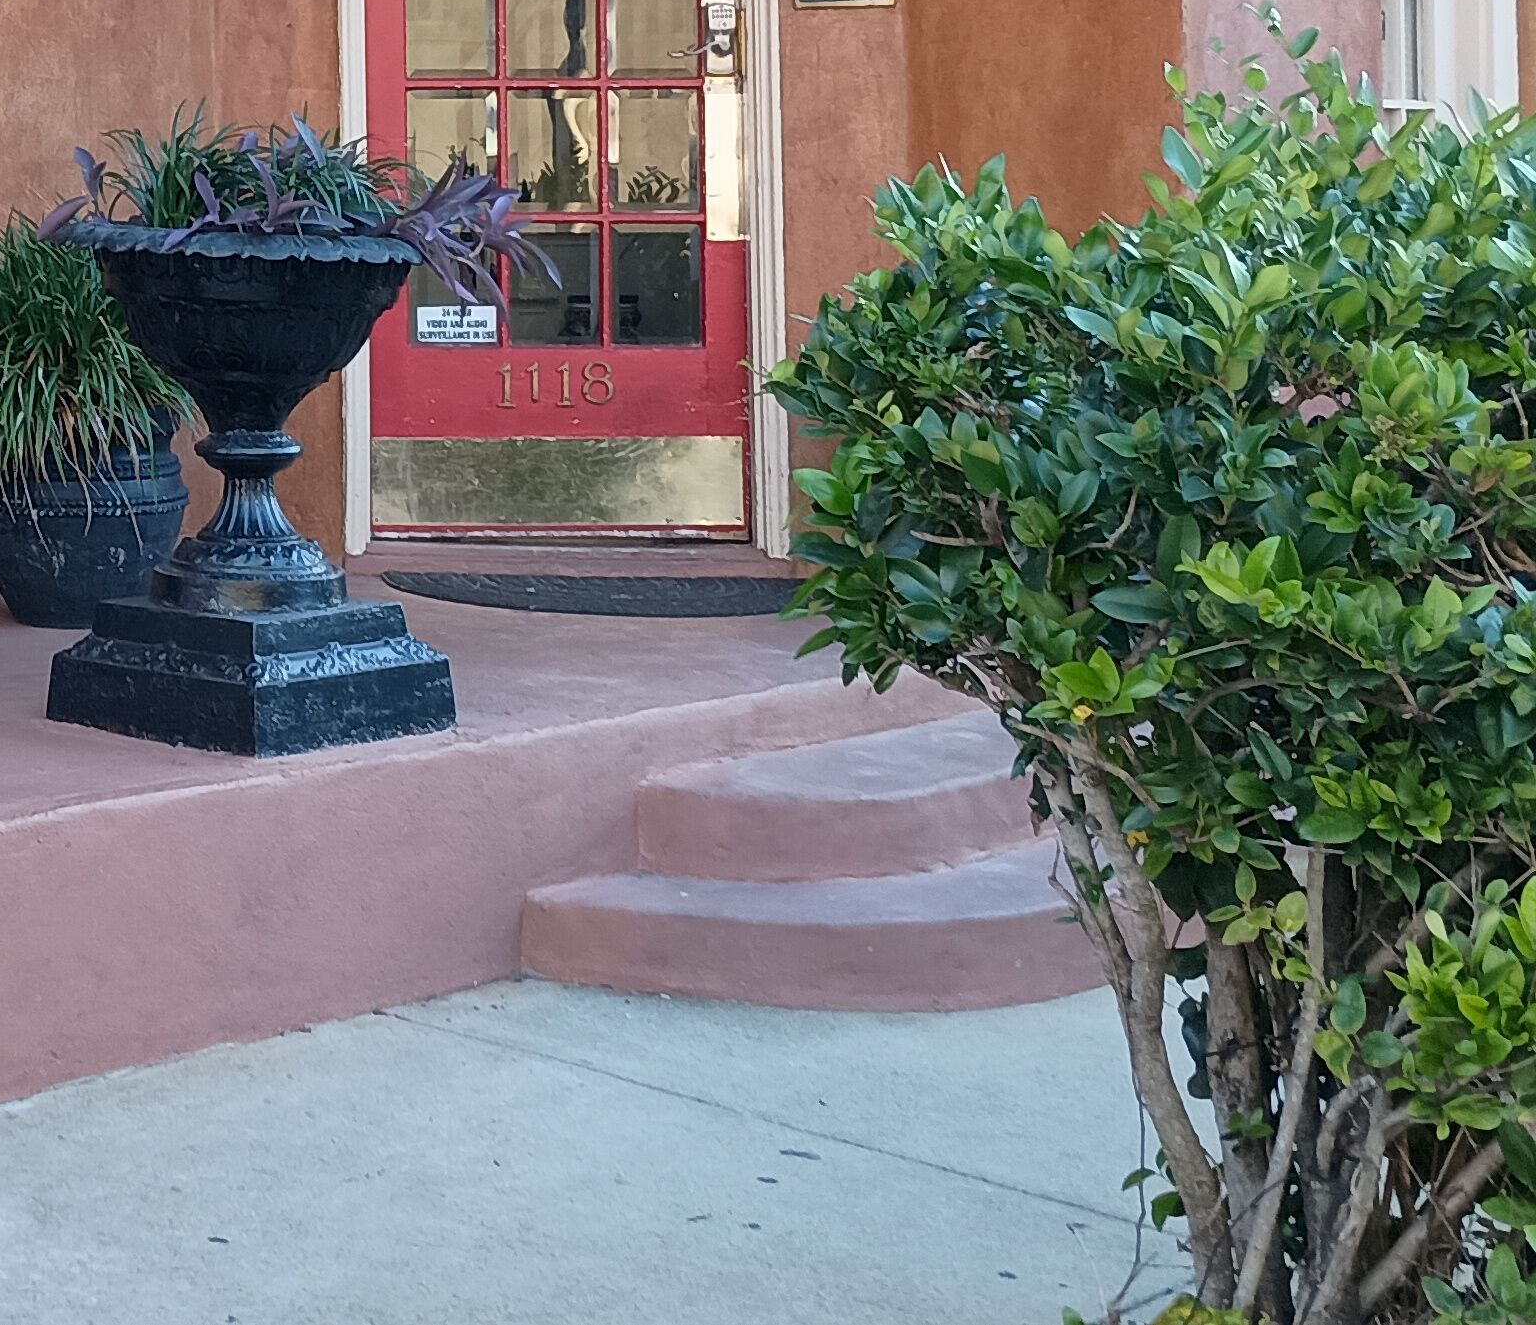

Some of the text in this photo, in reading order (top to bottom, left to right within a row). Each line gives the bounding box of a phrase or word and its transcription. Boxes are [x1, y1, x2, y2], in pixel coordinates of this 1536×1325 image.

[426, 319, 448, 328] VIDEO
[418, 330, 471, 340] SURVEILLANCE
[495, 360, 615, 409] 1118
